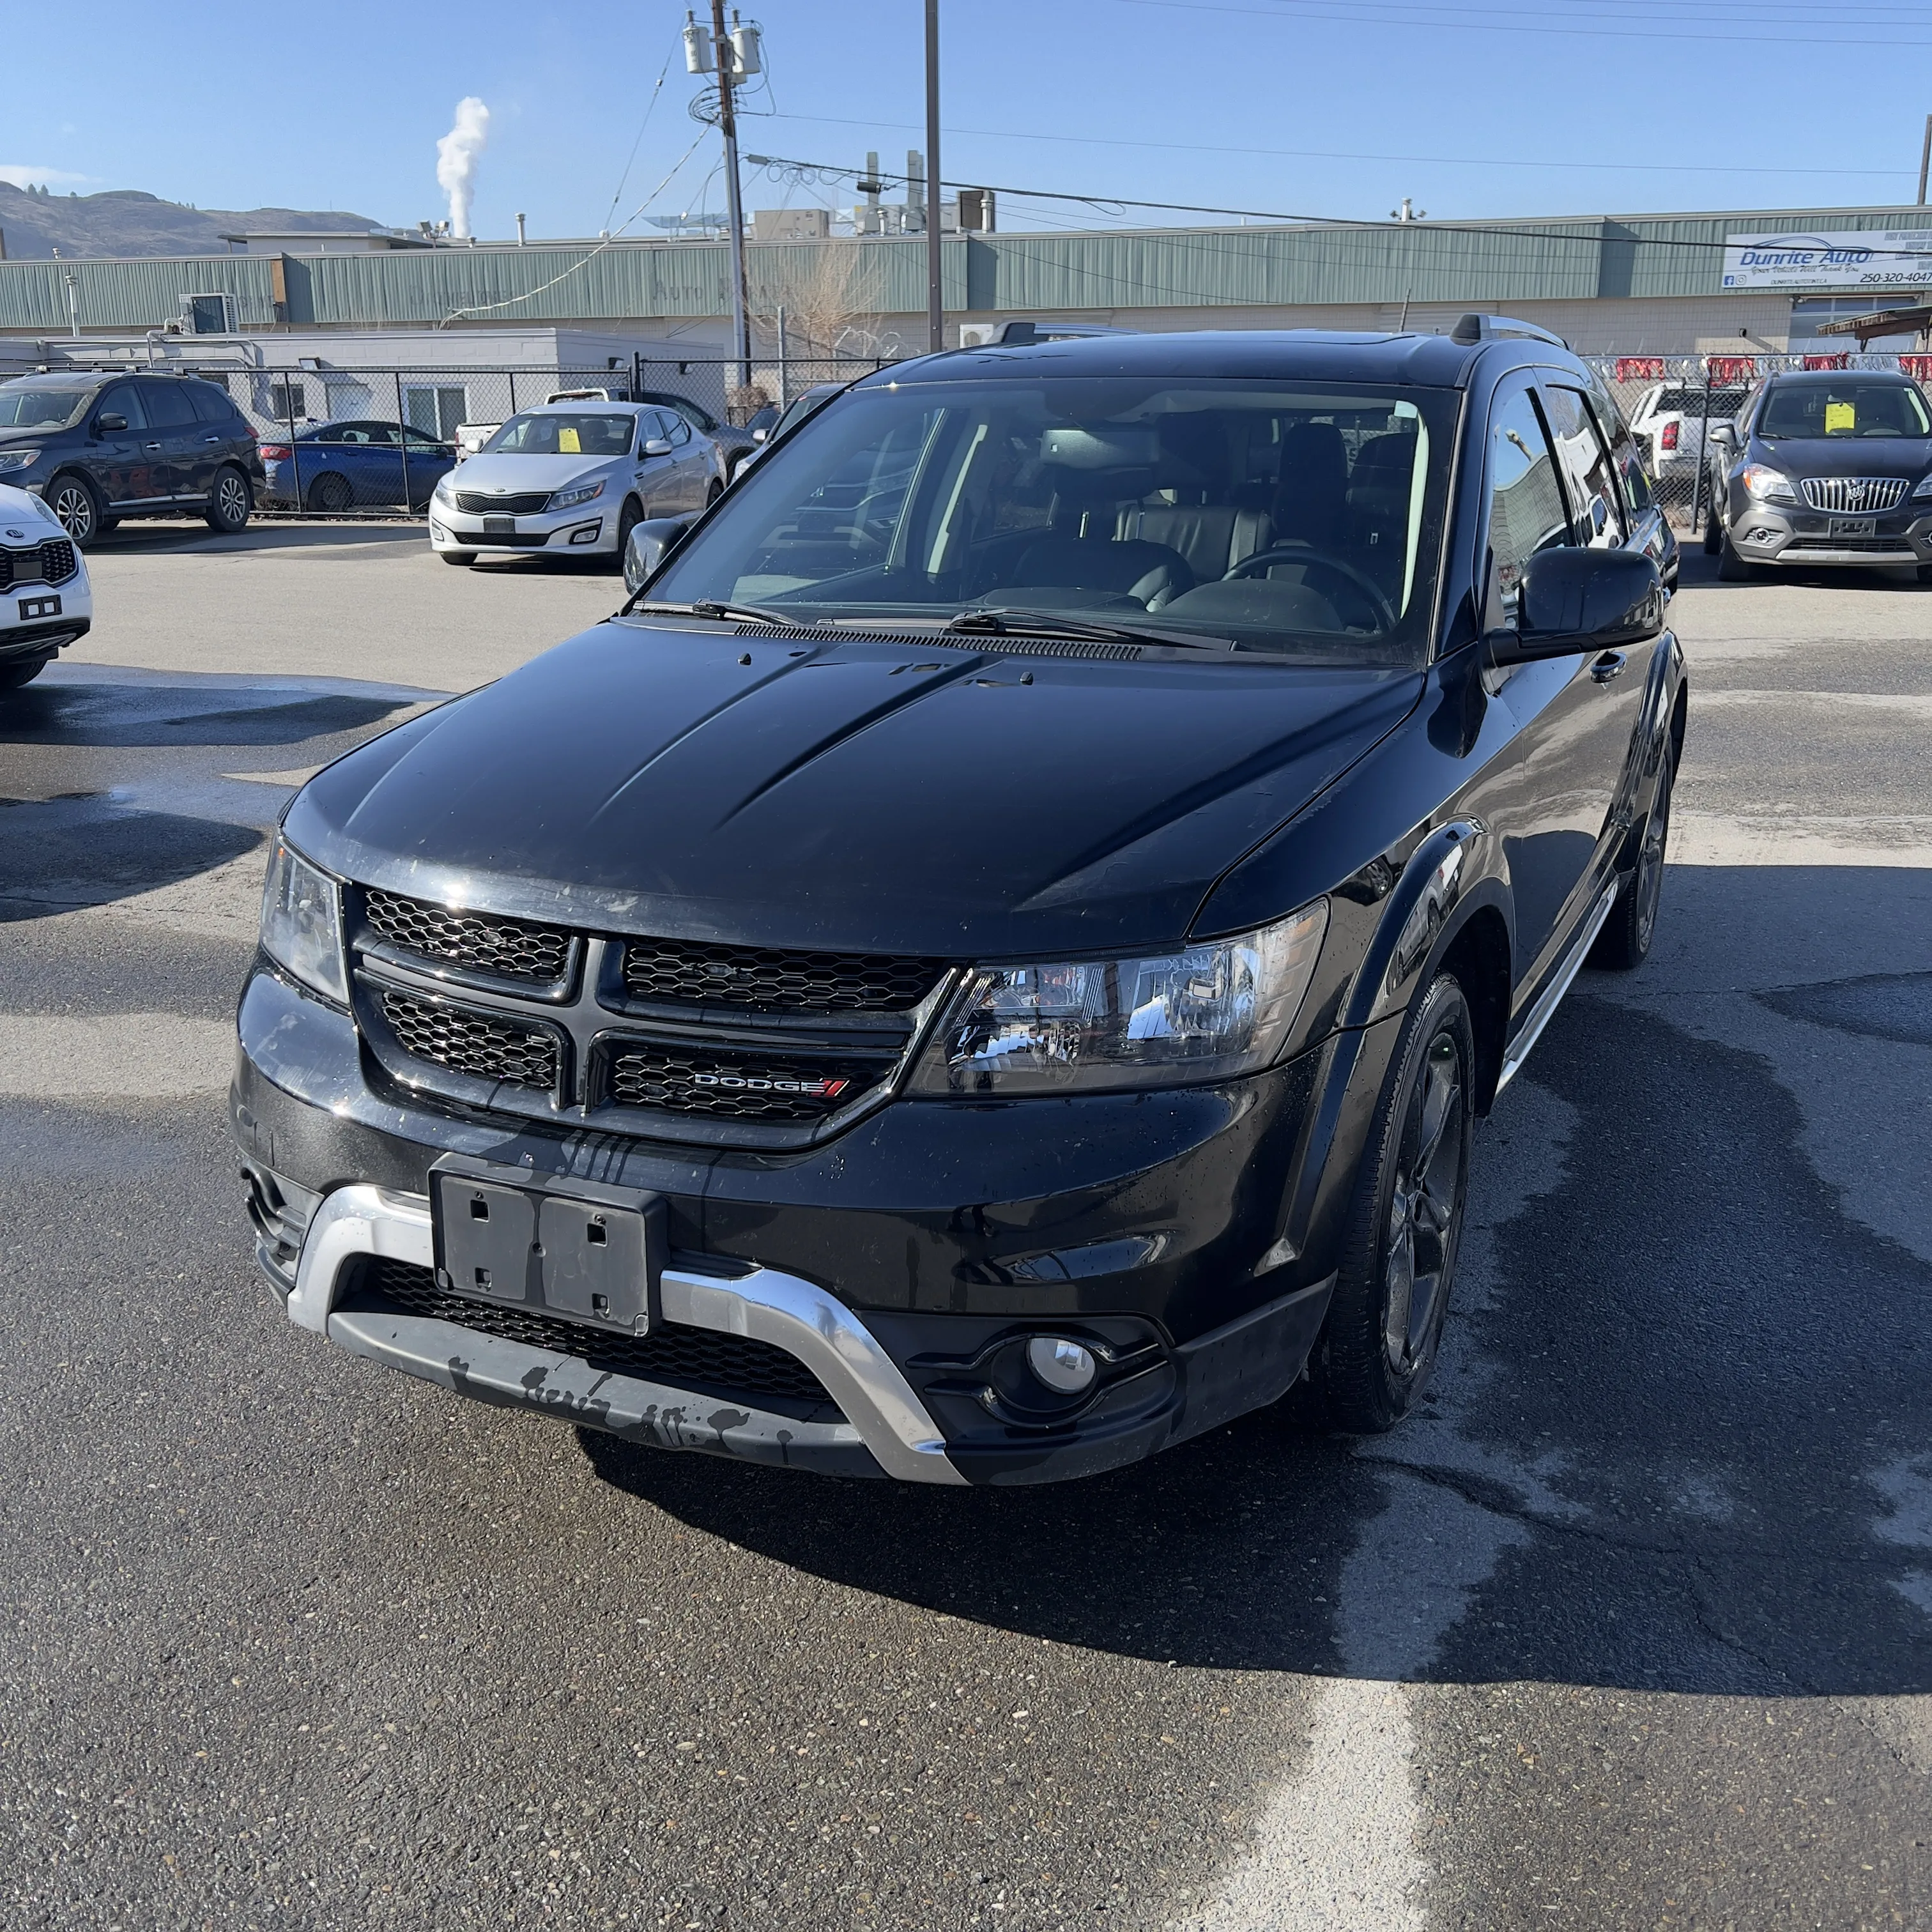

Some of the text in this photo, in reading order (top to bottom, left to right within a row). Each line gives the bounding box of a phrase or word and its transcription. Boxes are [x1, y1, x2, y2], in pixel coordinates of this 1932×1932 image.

[1740, 250, 1869, 265] Dunrite Auto
[1860, 272, 1932, 283] 250-320-4047
[694, 1073, 825, 1092] DODGE
